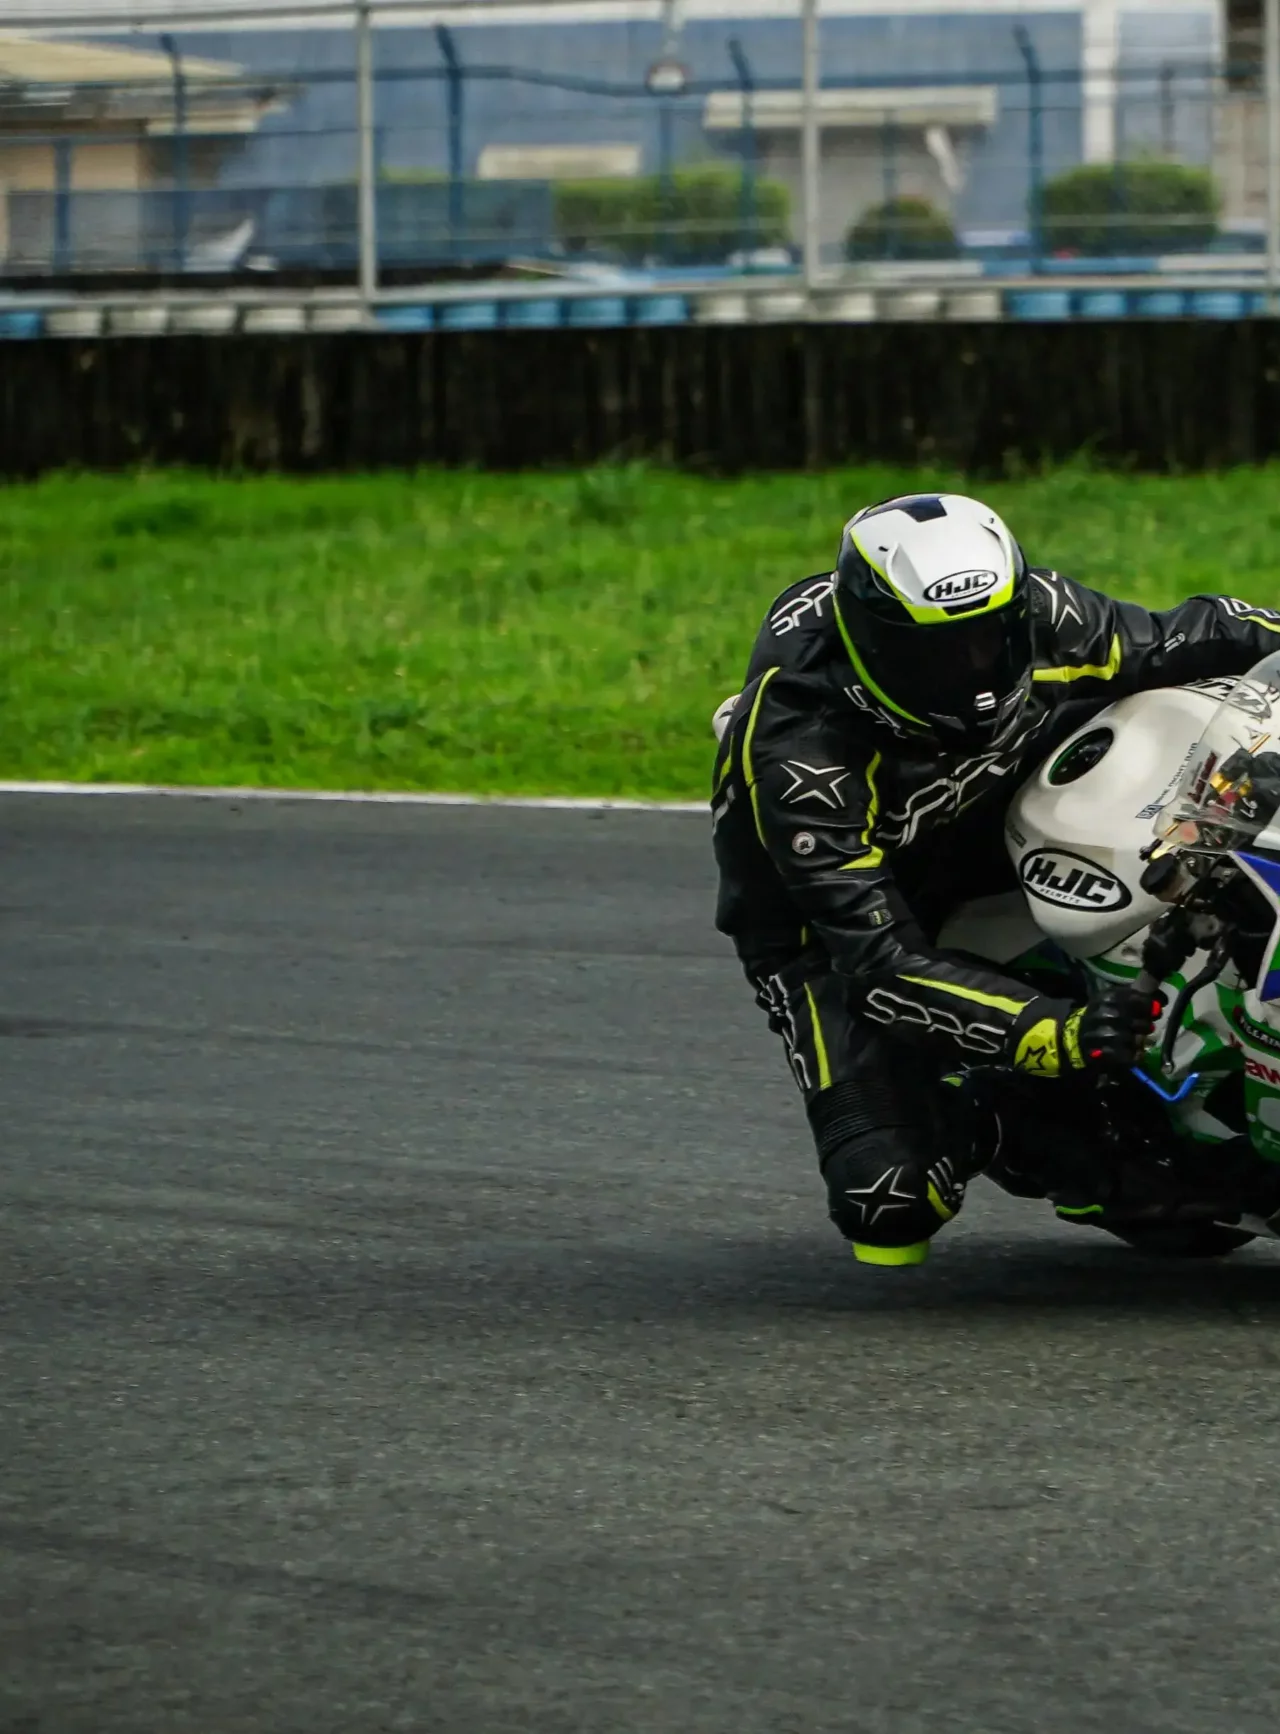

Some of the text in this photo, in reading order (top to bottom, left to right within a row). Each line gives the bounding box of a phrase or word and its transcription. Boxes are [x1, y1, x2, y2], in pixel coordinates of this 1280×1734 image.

[770, 572, 838, 637] SPR
[935, 573, 988, 600] HJC
[1023, 857, 1117, 904] HJC
[1038, 887, 1081, 905] HELMETS
